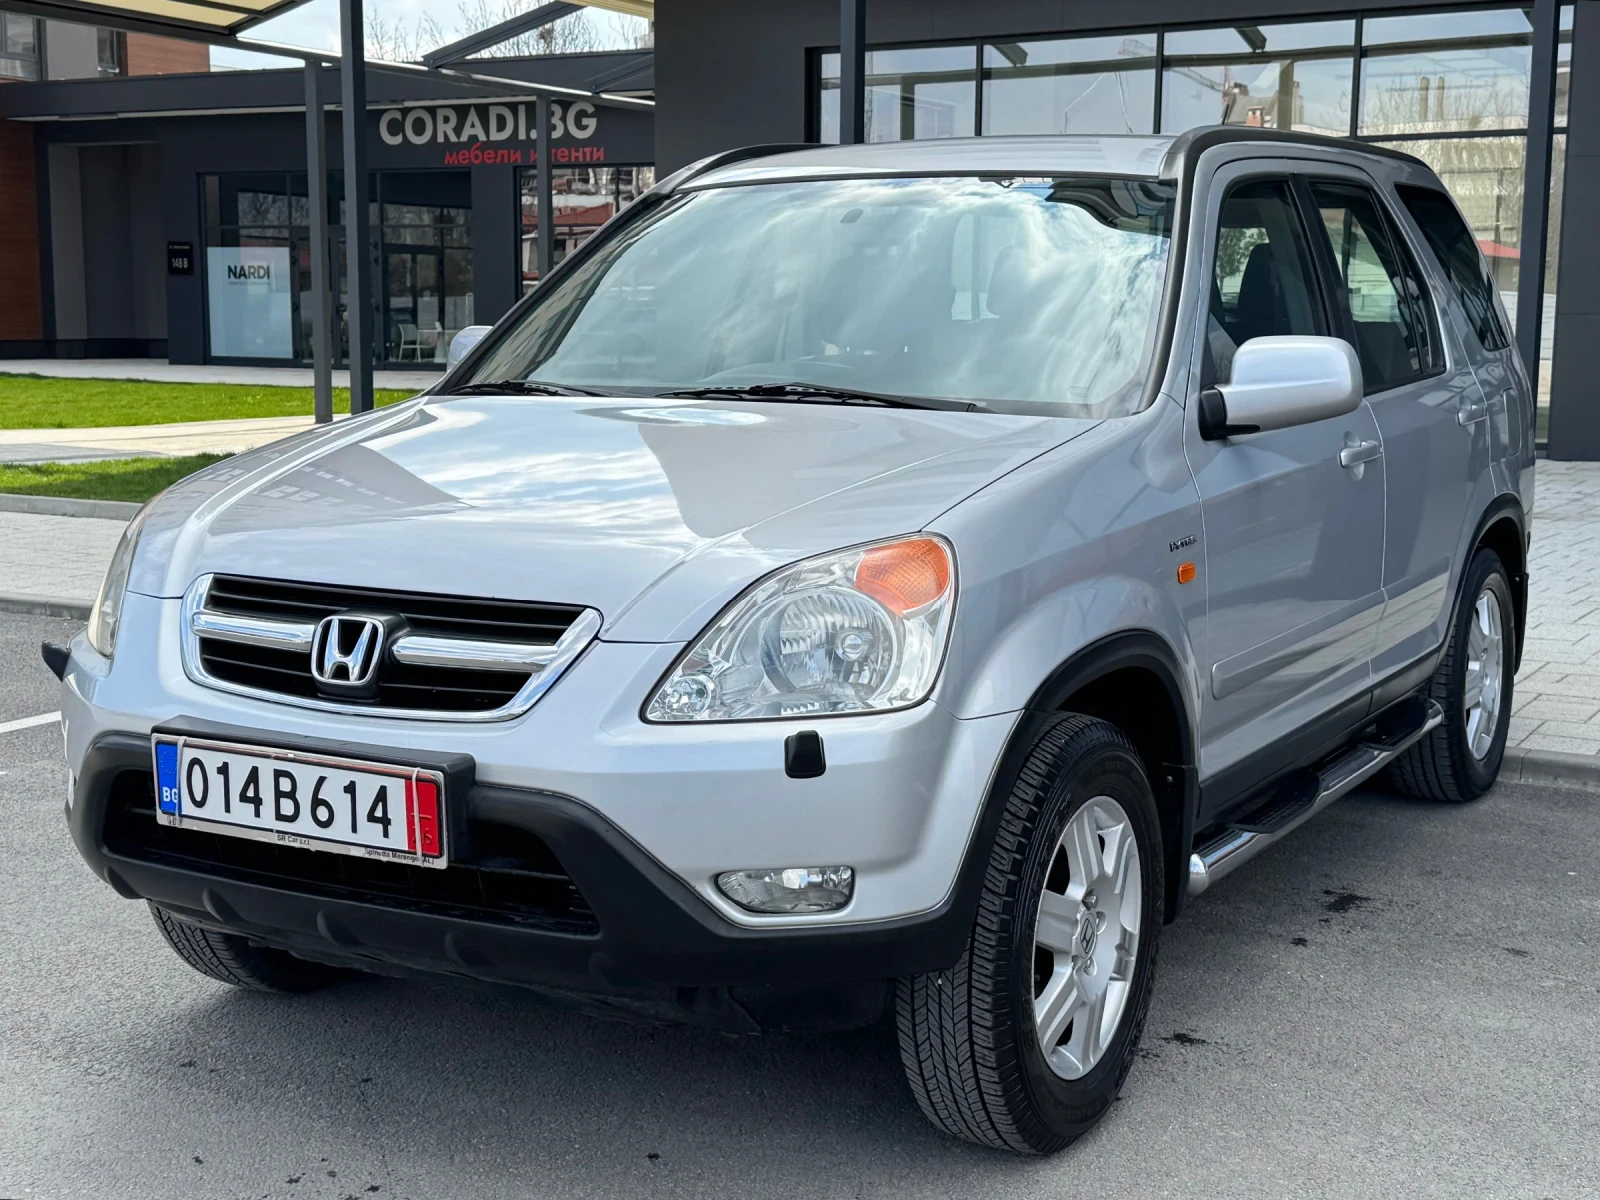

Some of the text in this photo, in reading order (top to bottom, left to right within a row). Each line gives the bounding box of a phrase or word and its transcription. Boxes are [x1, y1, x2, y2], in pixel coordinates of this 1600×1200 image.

[379, 101, 597, 145] CORADI.BG
[444, 142, 522, 165] мебели
[228, 265, 270, 279] NARDI
